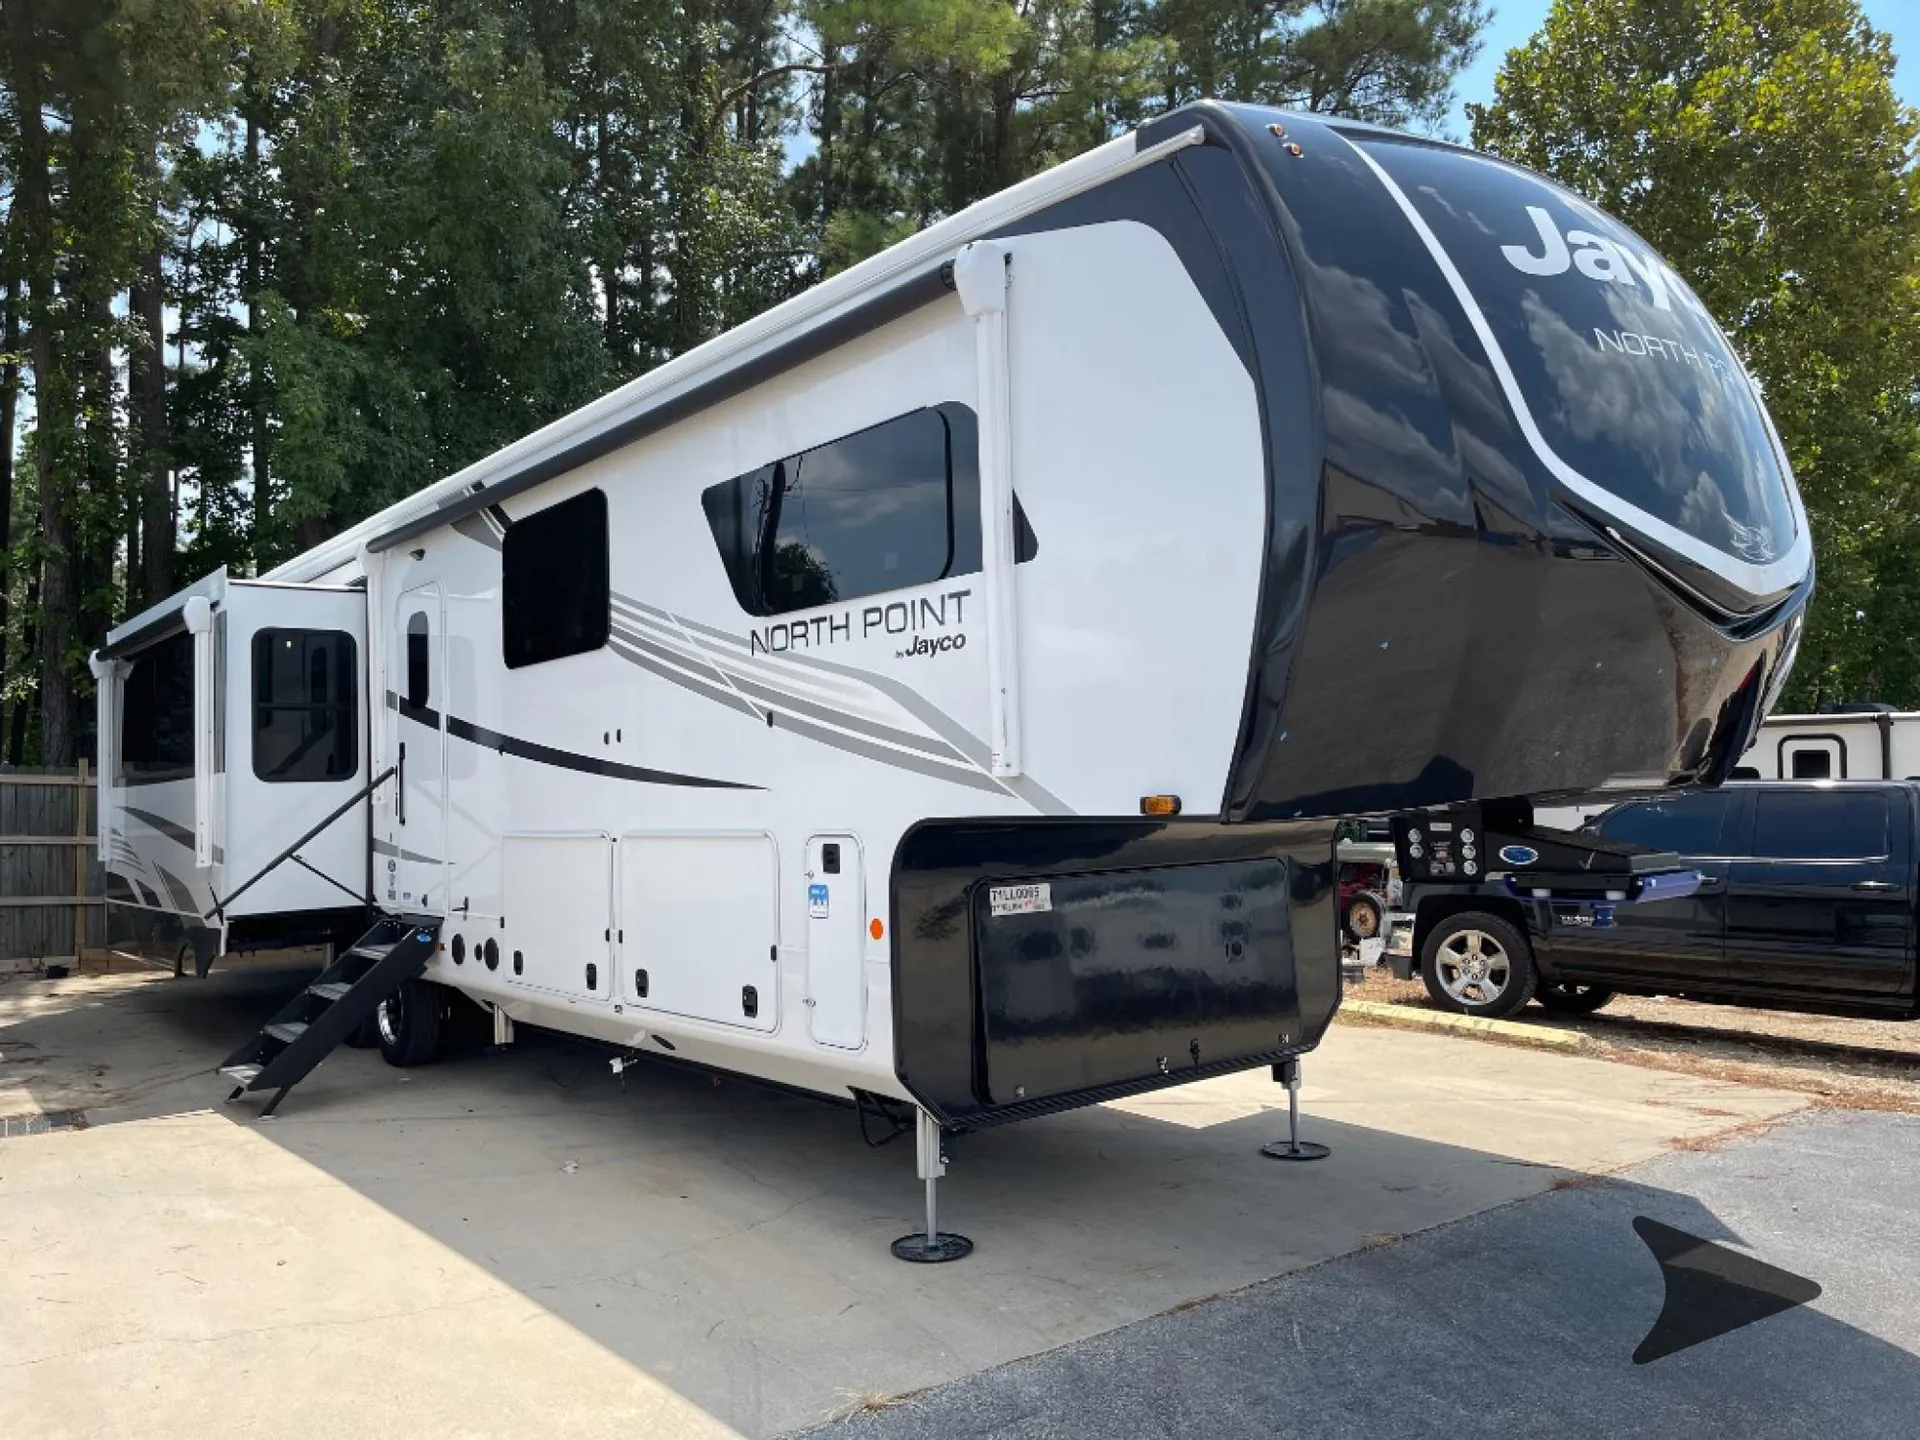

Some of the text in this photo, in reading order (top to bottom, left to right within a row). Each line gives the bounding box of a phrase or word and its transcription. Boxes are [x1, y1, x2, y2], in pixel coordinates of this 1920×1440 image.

[1593, 328, 1703, 368] NORTH
[751, 589, 971, 657] NORTH POINT
[905, 633, 966, 658] Jayco
